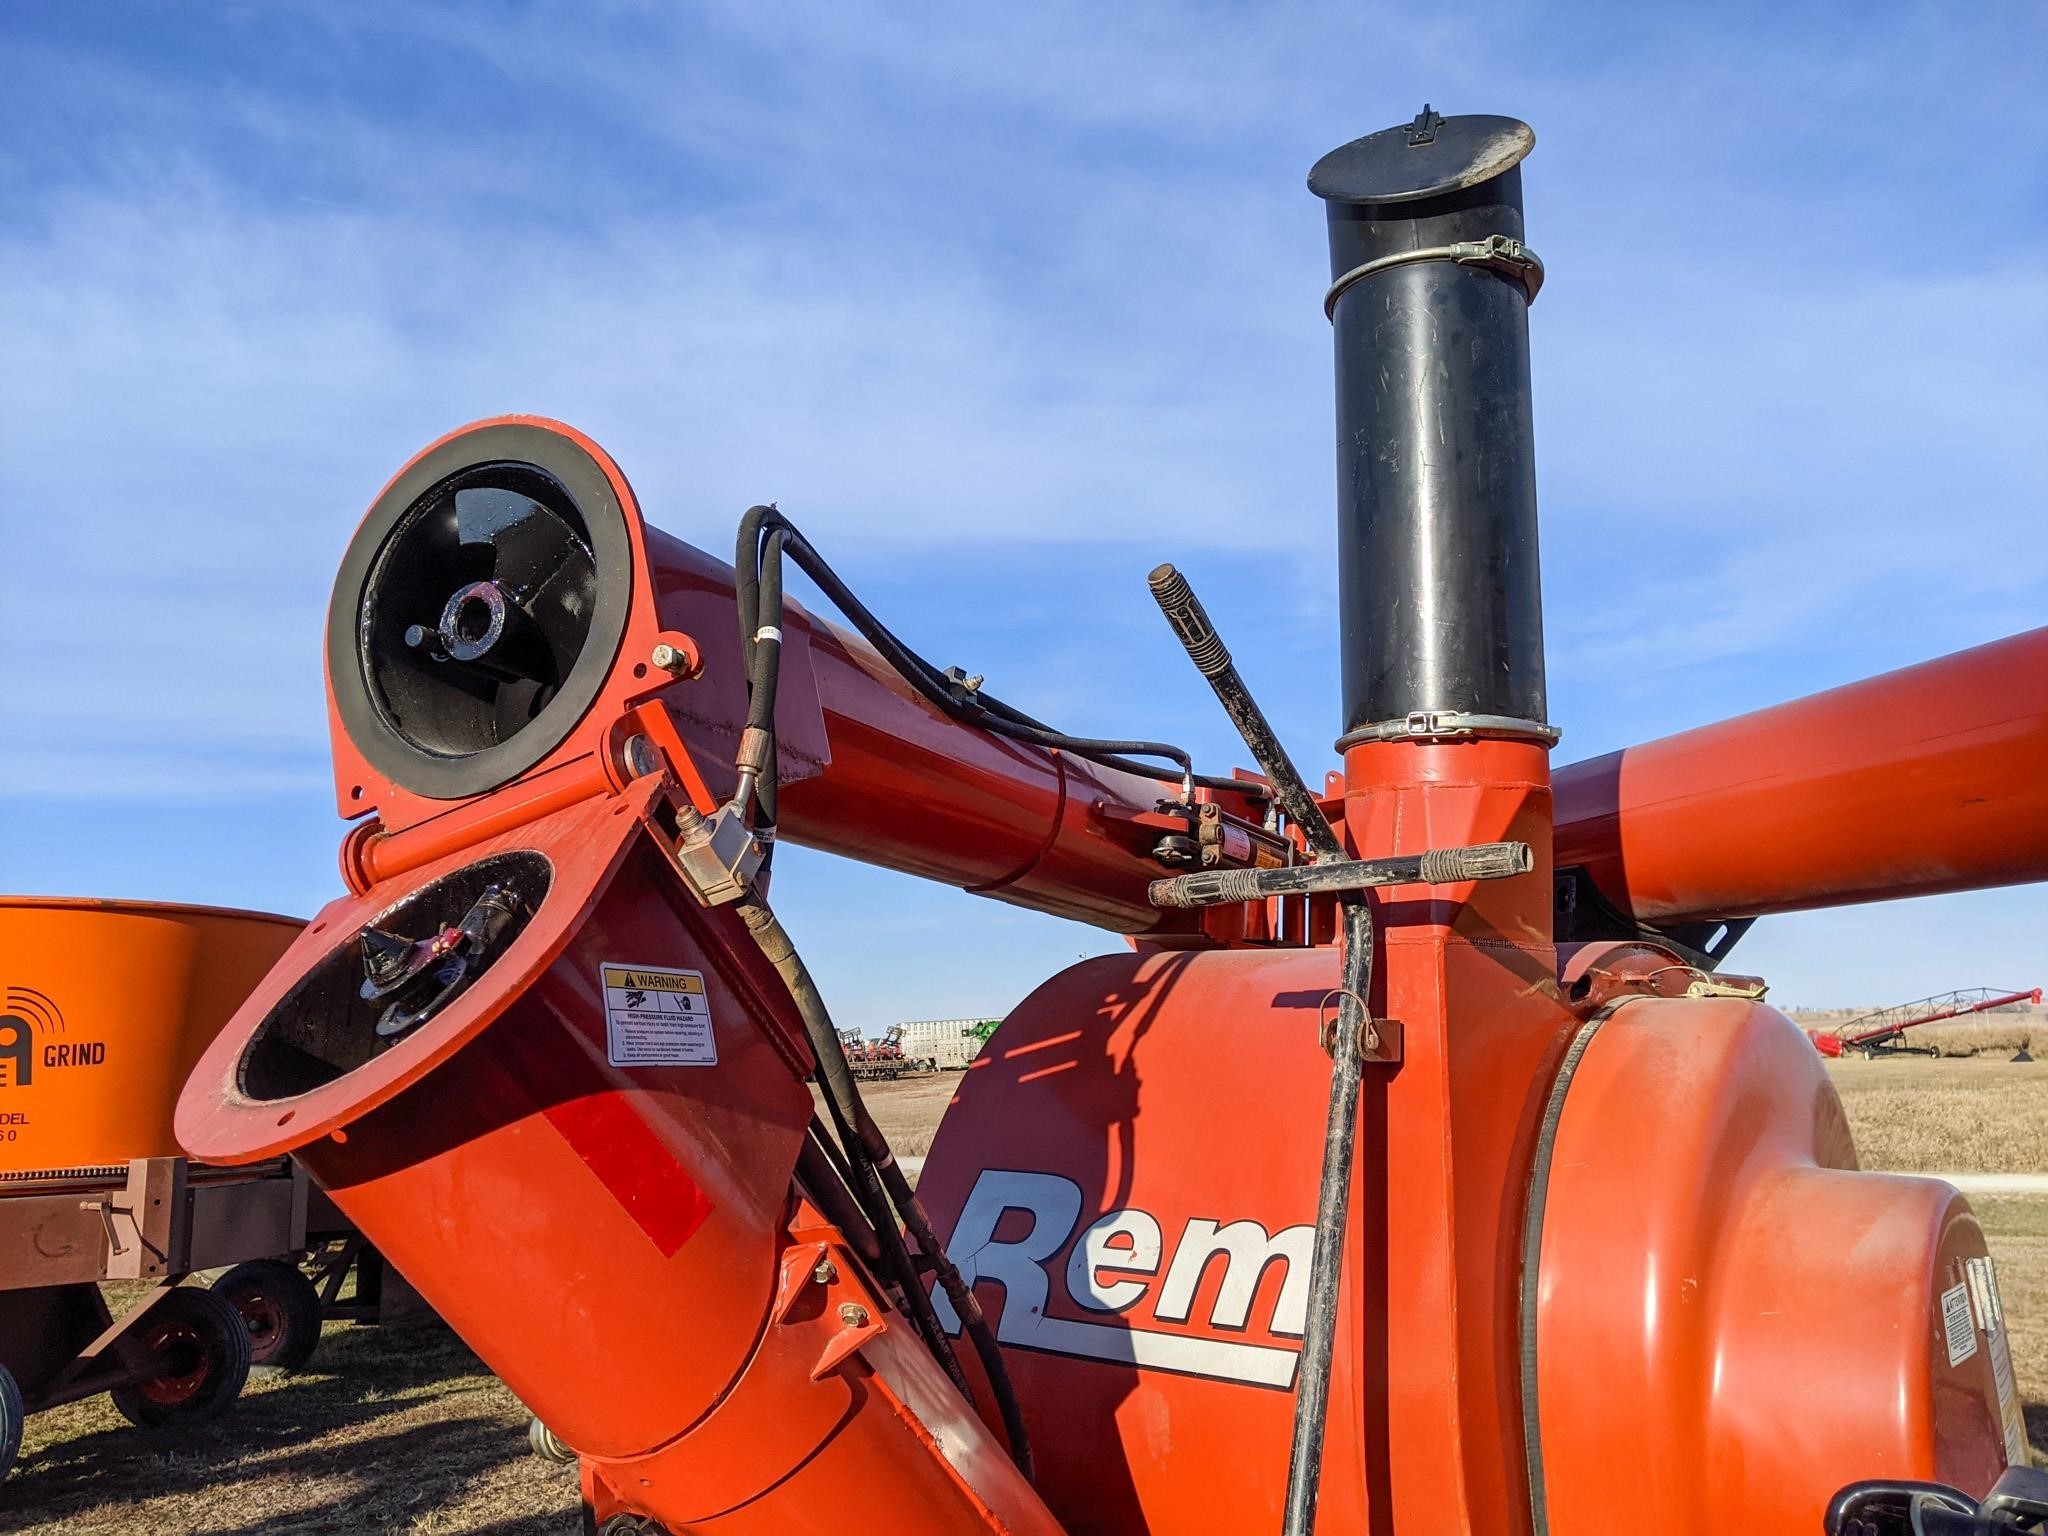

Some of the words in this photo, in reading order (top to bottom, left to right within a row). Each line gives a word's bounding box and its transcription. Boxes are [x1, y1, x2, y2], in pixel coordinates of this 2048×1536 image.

[637, 974, 687, 990] WARNING
[44, 1042, 105, 1068] GRIND
[928, 1168, 1317, 1344] Rem
